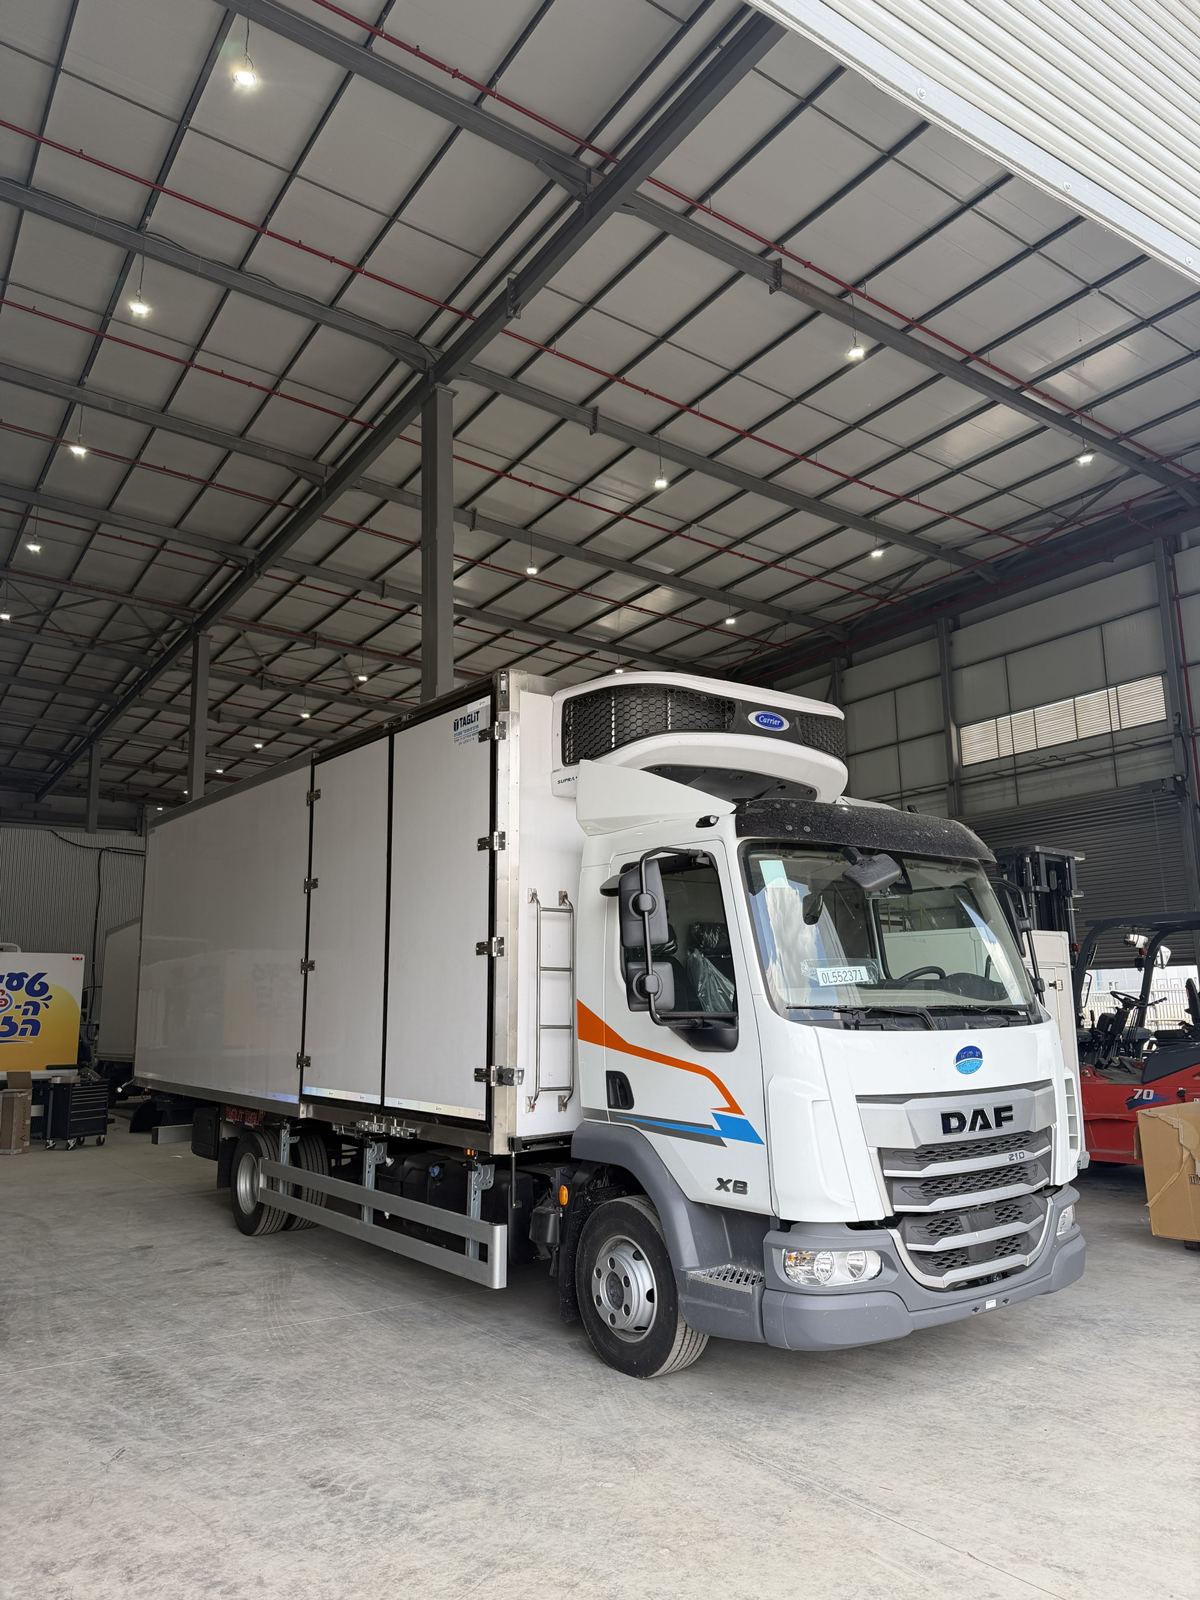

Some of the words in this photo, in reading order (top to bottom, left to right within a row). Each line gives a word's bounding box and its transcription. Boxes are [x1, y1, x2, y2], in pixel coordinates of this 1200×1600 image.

[758, 715, 781, 726] Carrier
[1133, 1088, 1154, 1100] 70
[941, 1105, 1013, 1134] DAF
[1008, 1152, 1024, 1161] 210
